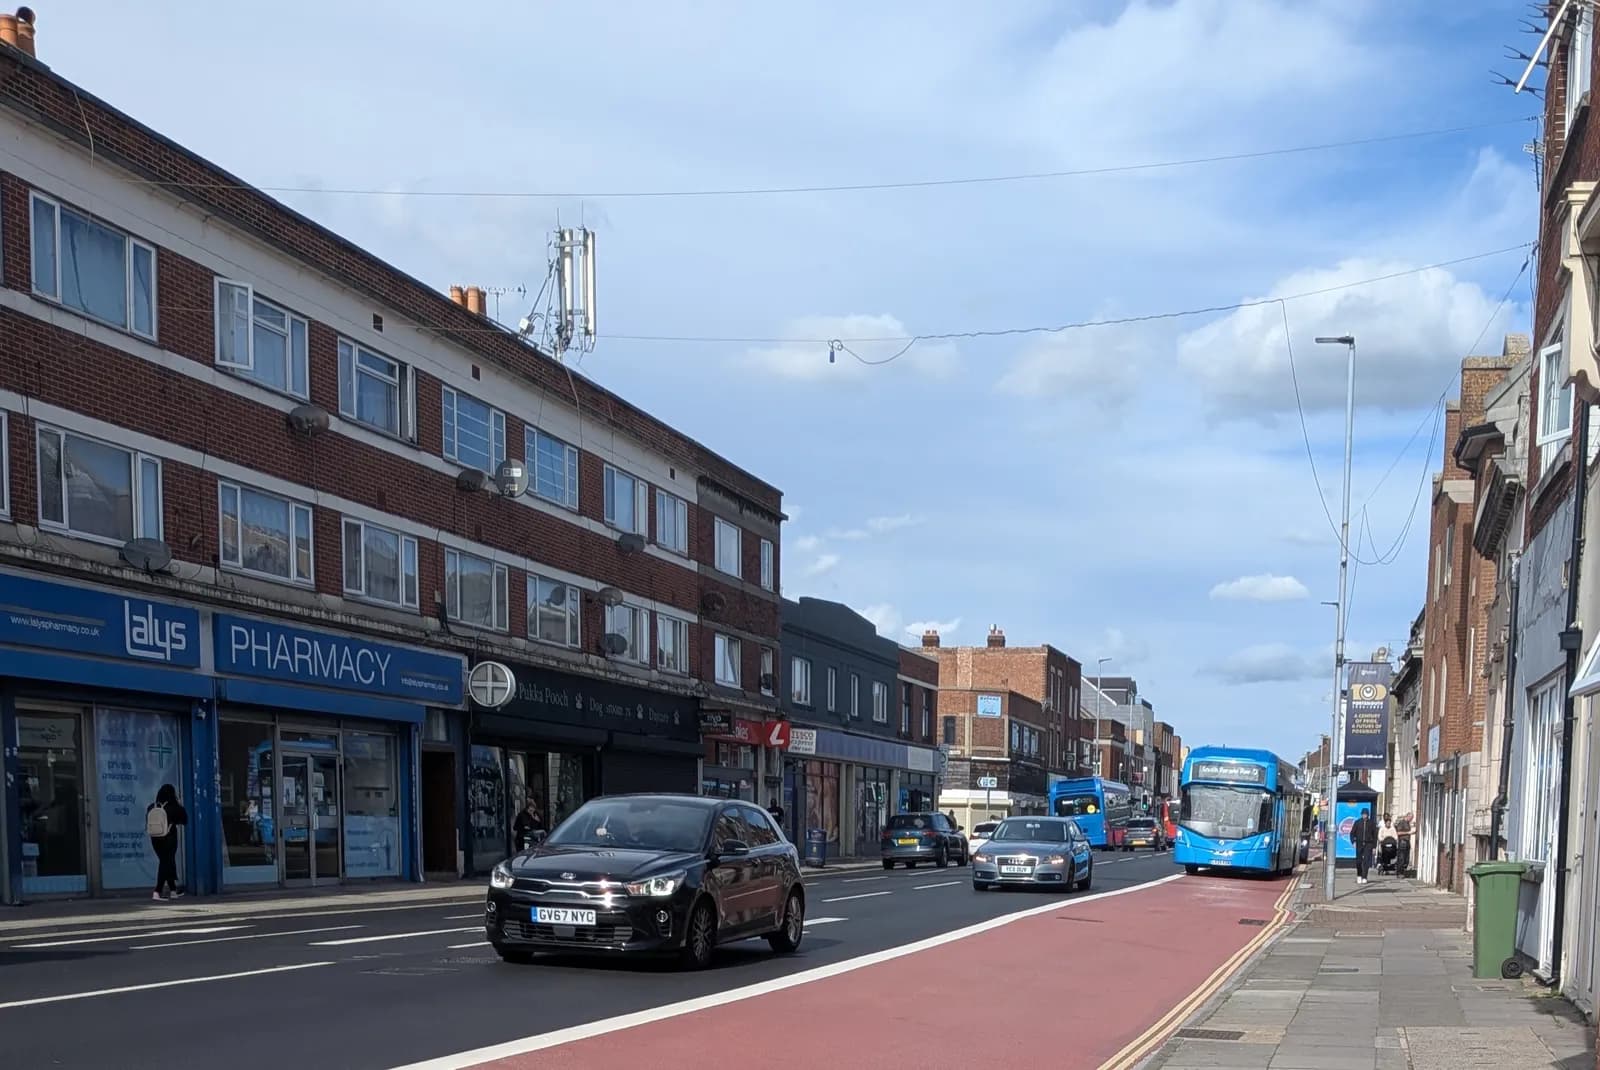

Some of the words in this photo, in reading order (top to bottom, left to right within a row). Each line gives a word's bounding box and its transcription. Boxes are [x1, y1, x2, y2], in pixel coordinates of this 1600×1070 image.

[9, 615, 101, 637] www.lalyspharmacy.co.uk
[230, 624, 392, 687] PHARMACY
[545, 687, 569, 708] Pooch
[791, 731, 814, 740] TESCO
[539, 908, 568, 921] GV67
